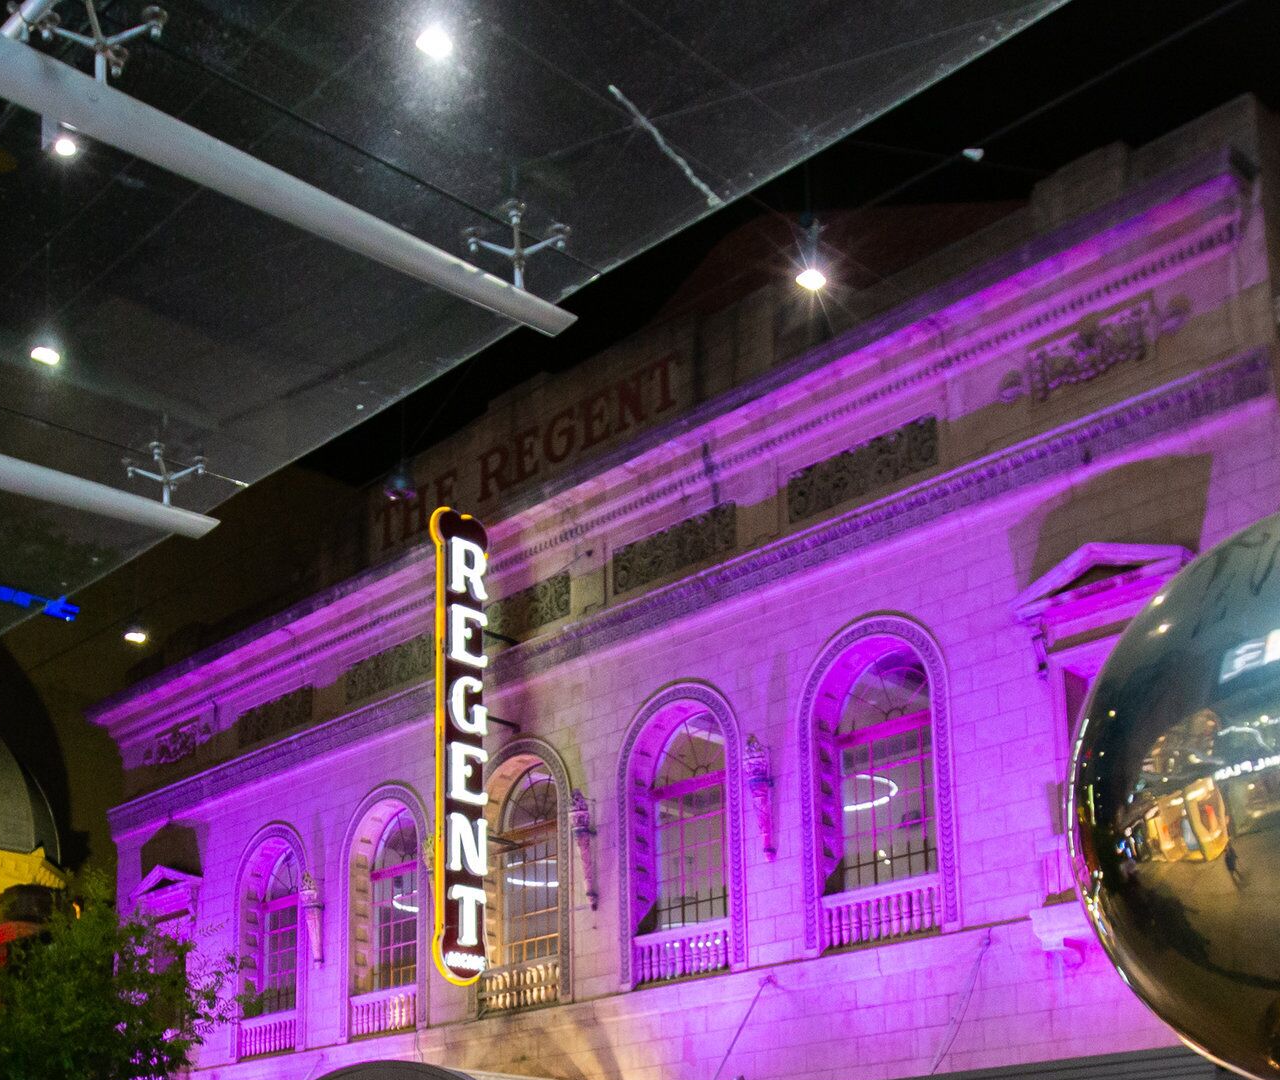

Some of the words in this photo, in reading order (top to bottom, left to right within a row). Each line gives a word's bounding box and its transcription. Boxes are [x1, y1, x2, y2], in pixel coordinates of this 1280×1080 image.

[374, 468, 459, 551] THE
[475, 353, 683, 503] REGENT
[445, 535, 489, 947] REGENT
